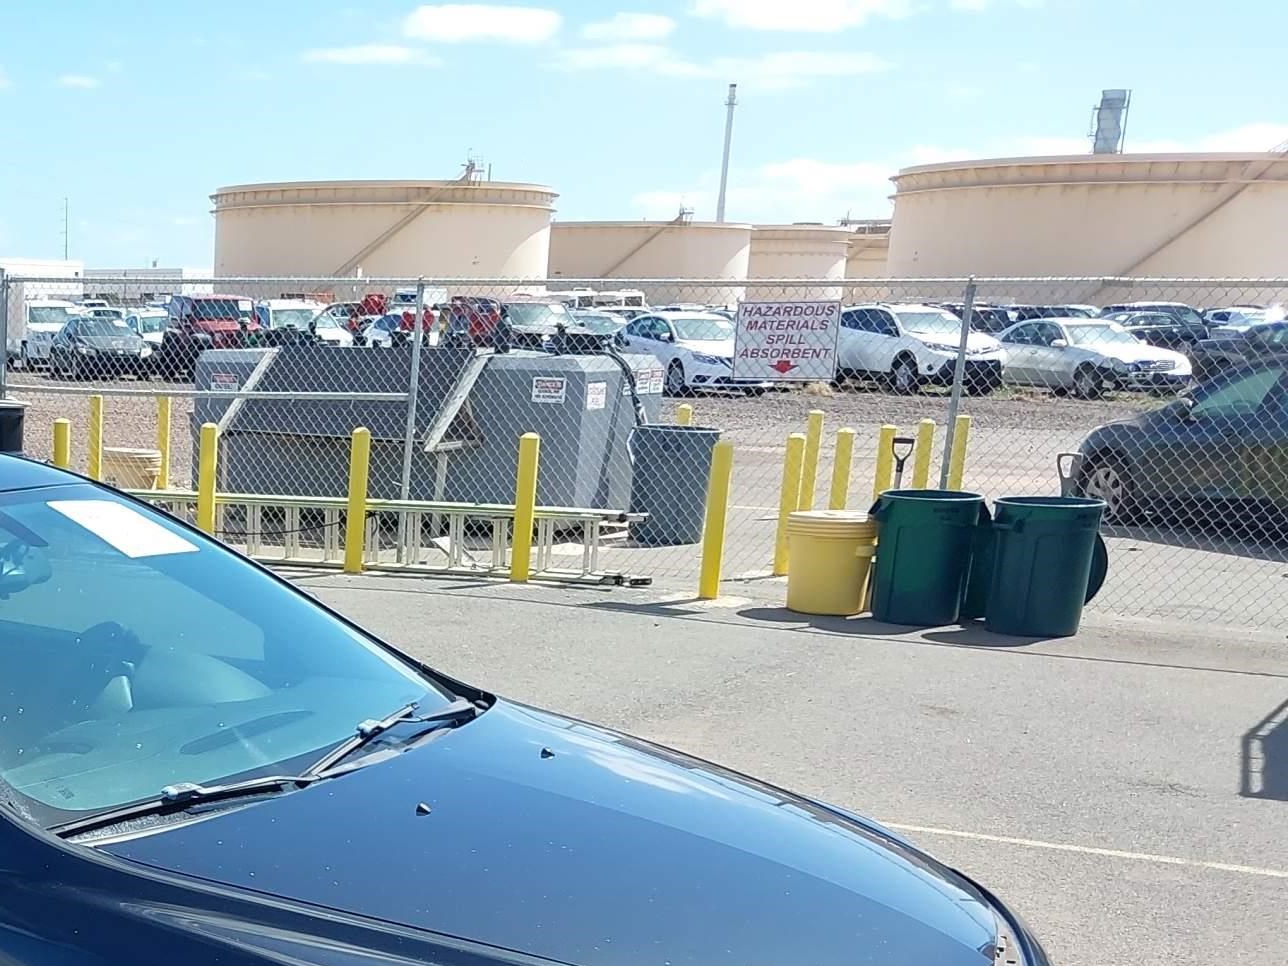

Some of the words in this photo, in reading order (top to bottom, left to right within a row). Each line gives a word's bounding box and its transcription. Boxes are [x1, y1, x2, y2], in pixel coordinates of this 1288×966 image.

[742, 305, 836, 317] HAZARDOUS
[745, 319, 830, 331] MATERIALS
[765, 334, 806, 345] SPILL
[739, 348, 832, 359] ABSORBENT
